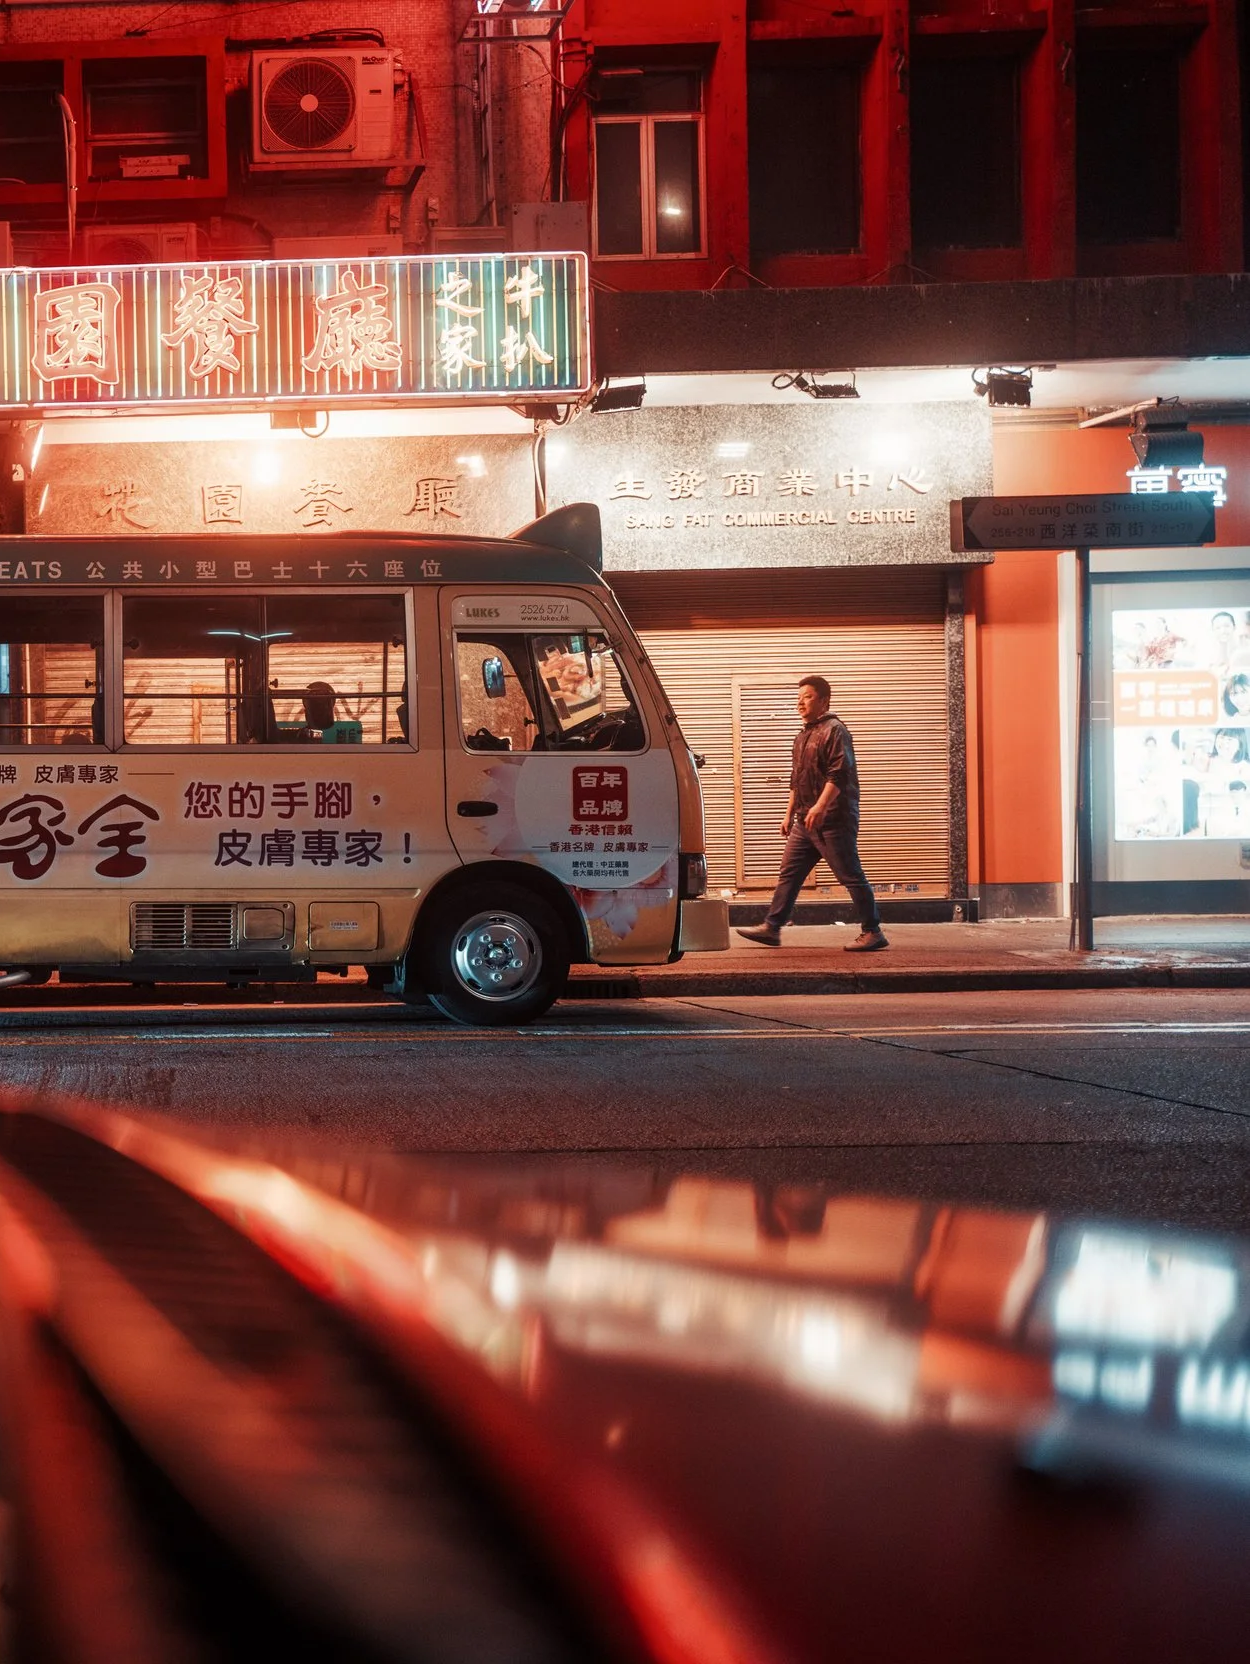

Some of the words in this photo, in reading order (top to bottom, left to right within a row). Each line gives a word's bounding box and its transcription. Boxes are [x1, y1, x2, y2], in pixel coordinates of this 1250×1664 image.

[609, 466, 935, 501] 生發商業中心
[625, 513, 675, 529] SANG
[682, 512, 712, 528] FAT
[721, 509, 838, 528] COMMERCIAL
[846, 507, 917, 525] CENTRE
[992, 503, 1014, 517] Sai
[1020, 503, 1061, 518] Yeung
[1065, 502, 1097, 515] Choi
[1102, 501, 1146, 514] Street
[1151, 500, 1193, 513] South
[1040, 522, 1144, 540] 西洋菜南街
[86, 560, 442, 579] 公共小型巴士十六座位
[466, 607, 501, 618] LUKES
[520, 604, 545, 615] 2526
[547, 604, 570, 615] 5771
[34, 765, 119, 784] 皮膚專家
[577, 771, 623, 789] 百年
[578, 800, 624, 817] 品牌
[550, 842, 595, 853] 香港名牌
[603, 842, 649, 853] 皮膚專家
